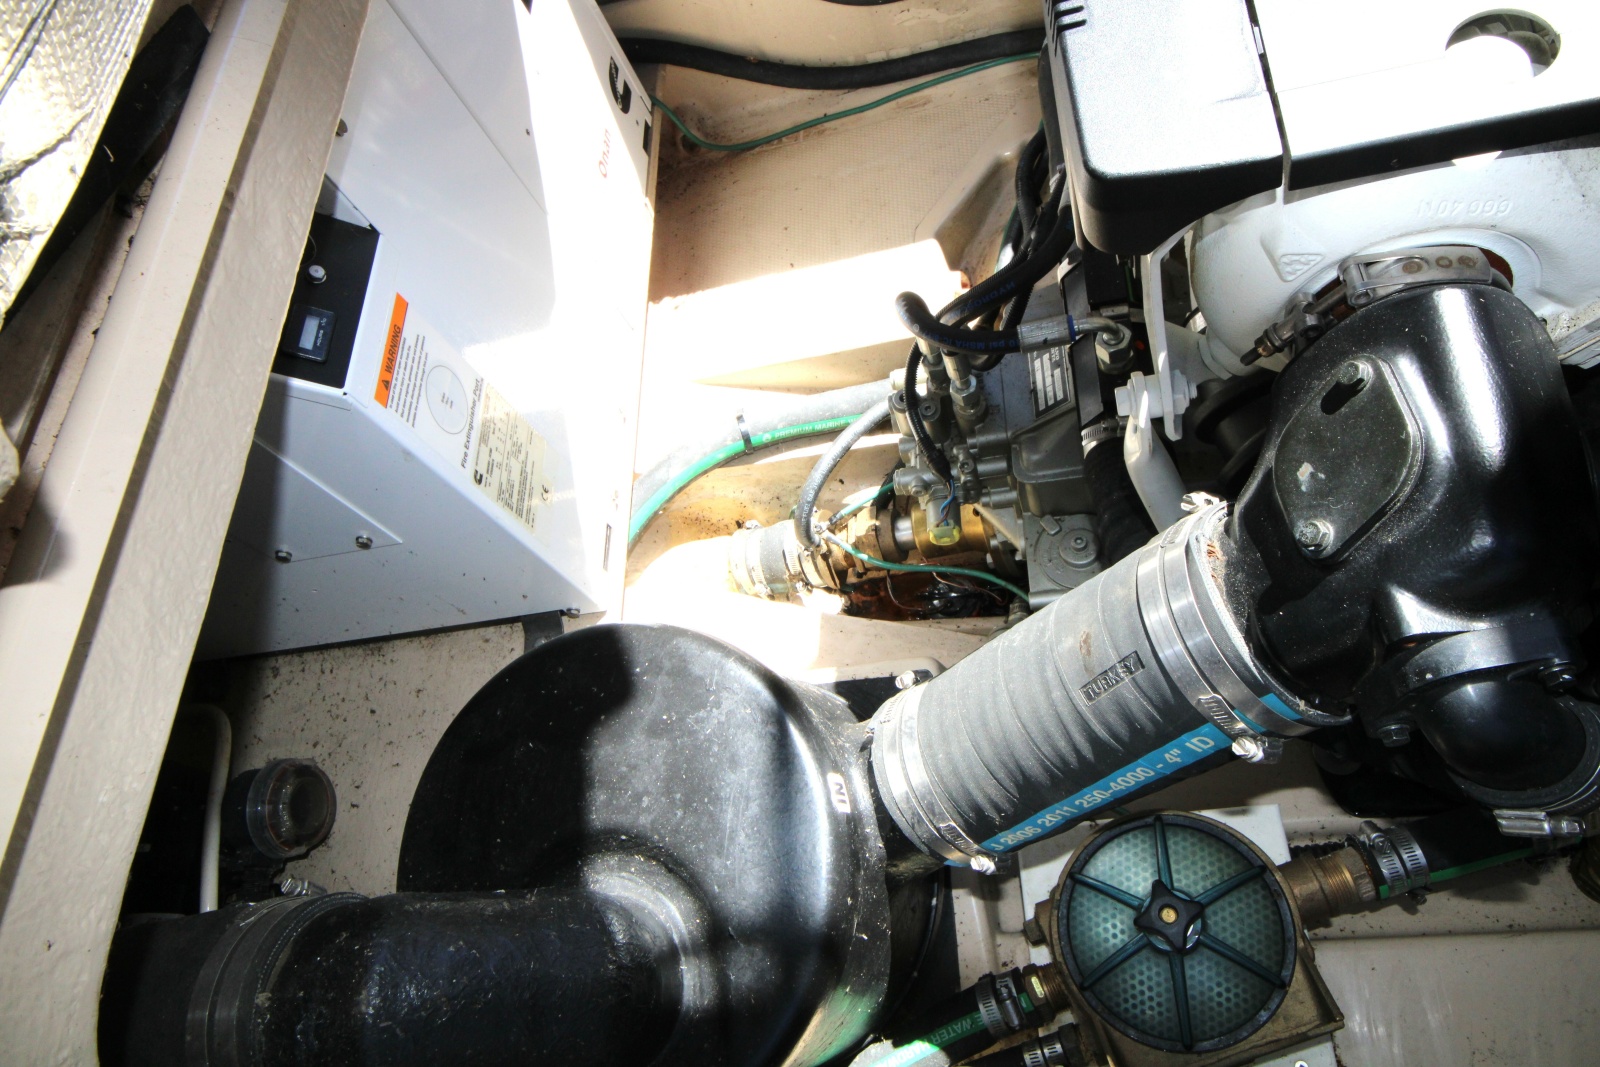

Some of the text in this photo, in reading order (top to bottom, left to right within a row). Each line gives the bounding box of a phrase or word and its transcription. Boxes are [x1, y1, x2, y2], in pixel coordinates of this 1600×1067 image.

[598, 128, 611, 178] Onan
[385, 324, 401, 374] WARNING
[460, 451, 468, 468] Fire
[464, 398, 476, 450] Extinguisher
[774, 426, 813, 438] PREMIUM
[814, 419, 845, 430] MARINE
[1084, 658, 1136, 701] TURKEY
[1003, 826, 1041, 847] 2006
[1045, 806, 1078, 827] 2011
[1075, 766, 1156, 809] 250-4000
[1166, 748, 1183, 765] 4"
[1185, 736, 1215, 758] ID
[932, 1018, 973, 1045] WATER
